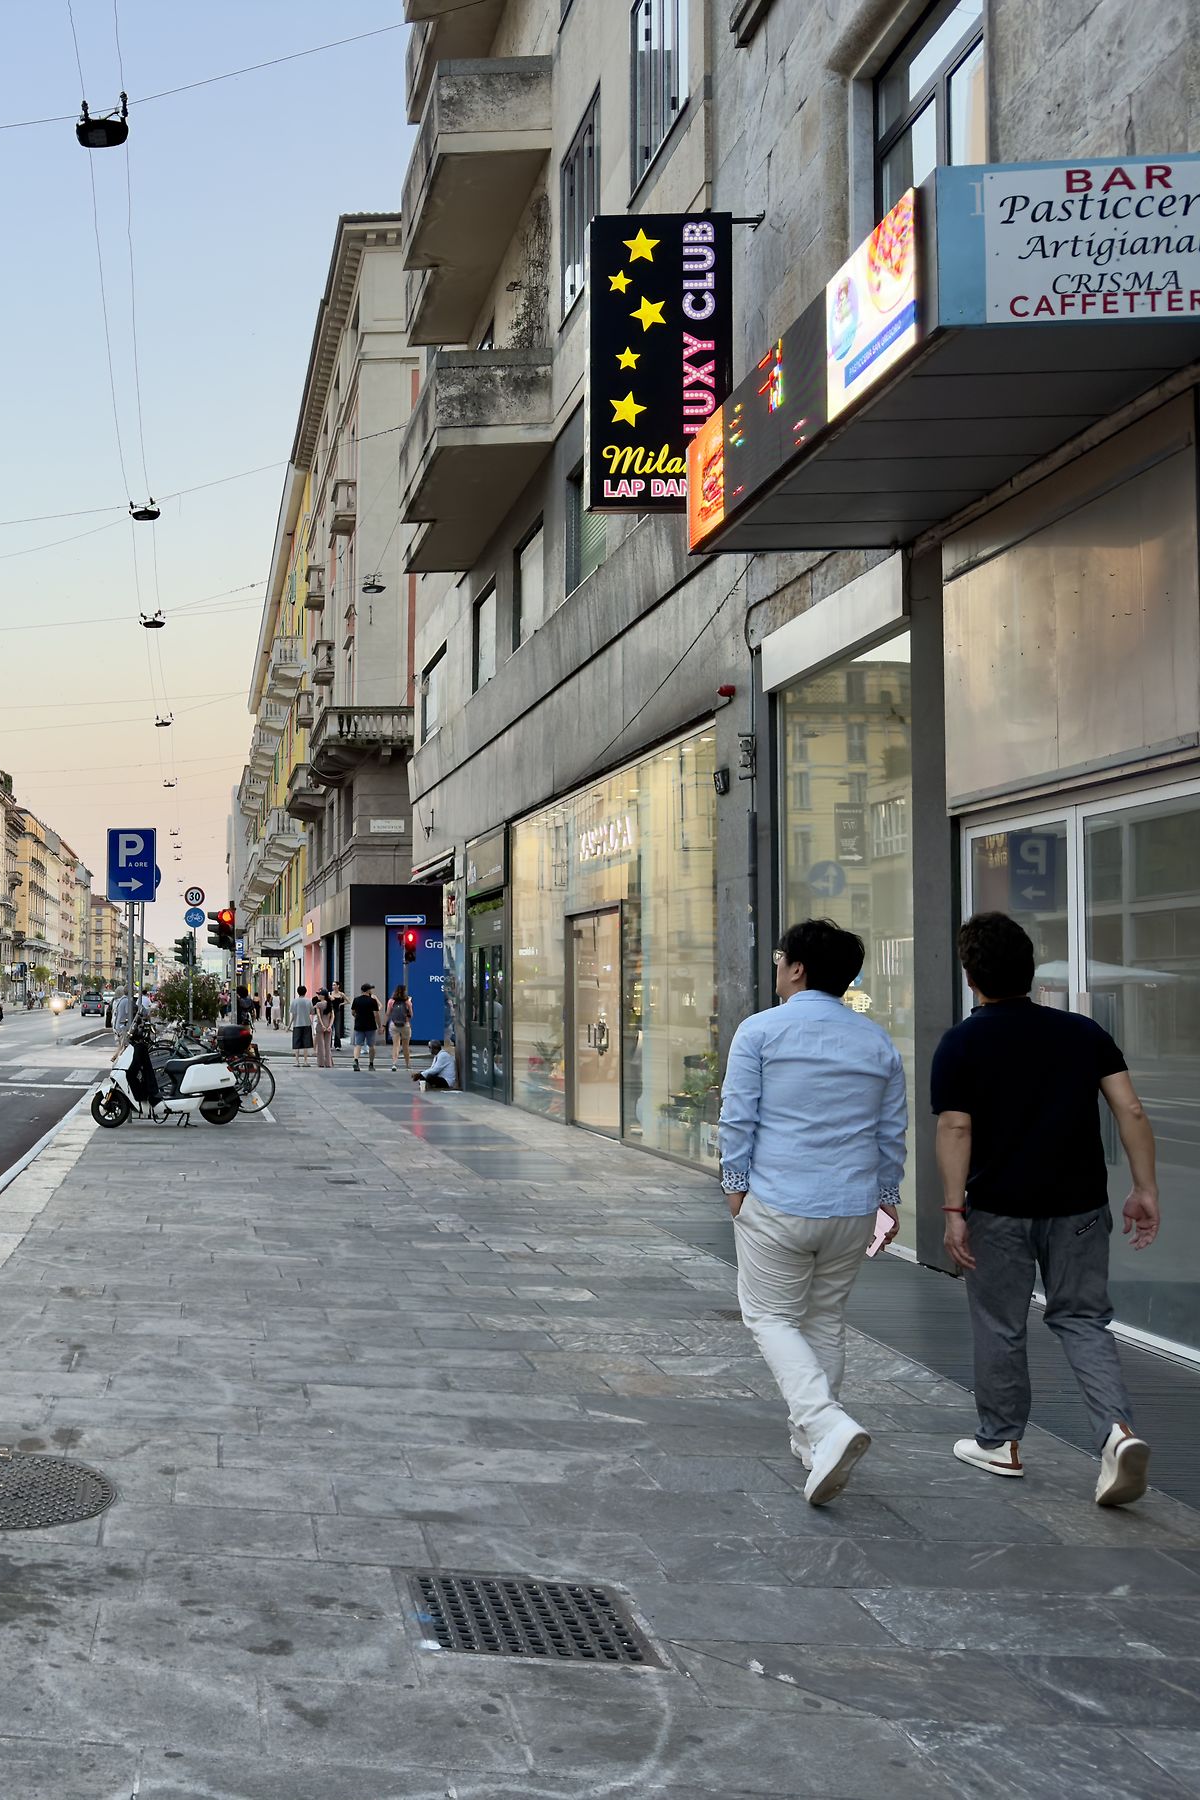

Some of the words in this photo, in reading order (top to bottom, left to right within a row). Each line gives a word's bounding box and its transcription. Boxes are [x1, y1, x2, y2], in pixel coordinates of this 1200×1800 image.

[1066, 165, 1173, 193] BAR
[1018, 231, 1200, 266] Artigiana
[682, 221, 716, 321] CLUB
[1052, 270, 1183, 295] CRISMA
[602, 443, 687, 476] Mila
[603, 478, 645, 498] LAP
[650, 478, 688, 498] DAN
[118, 833, 145, 868] P
[189, 892, 201, 901] 30
[424, 939, 443, 948] Gra
